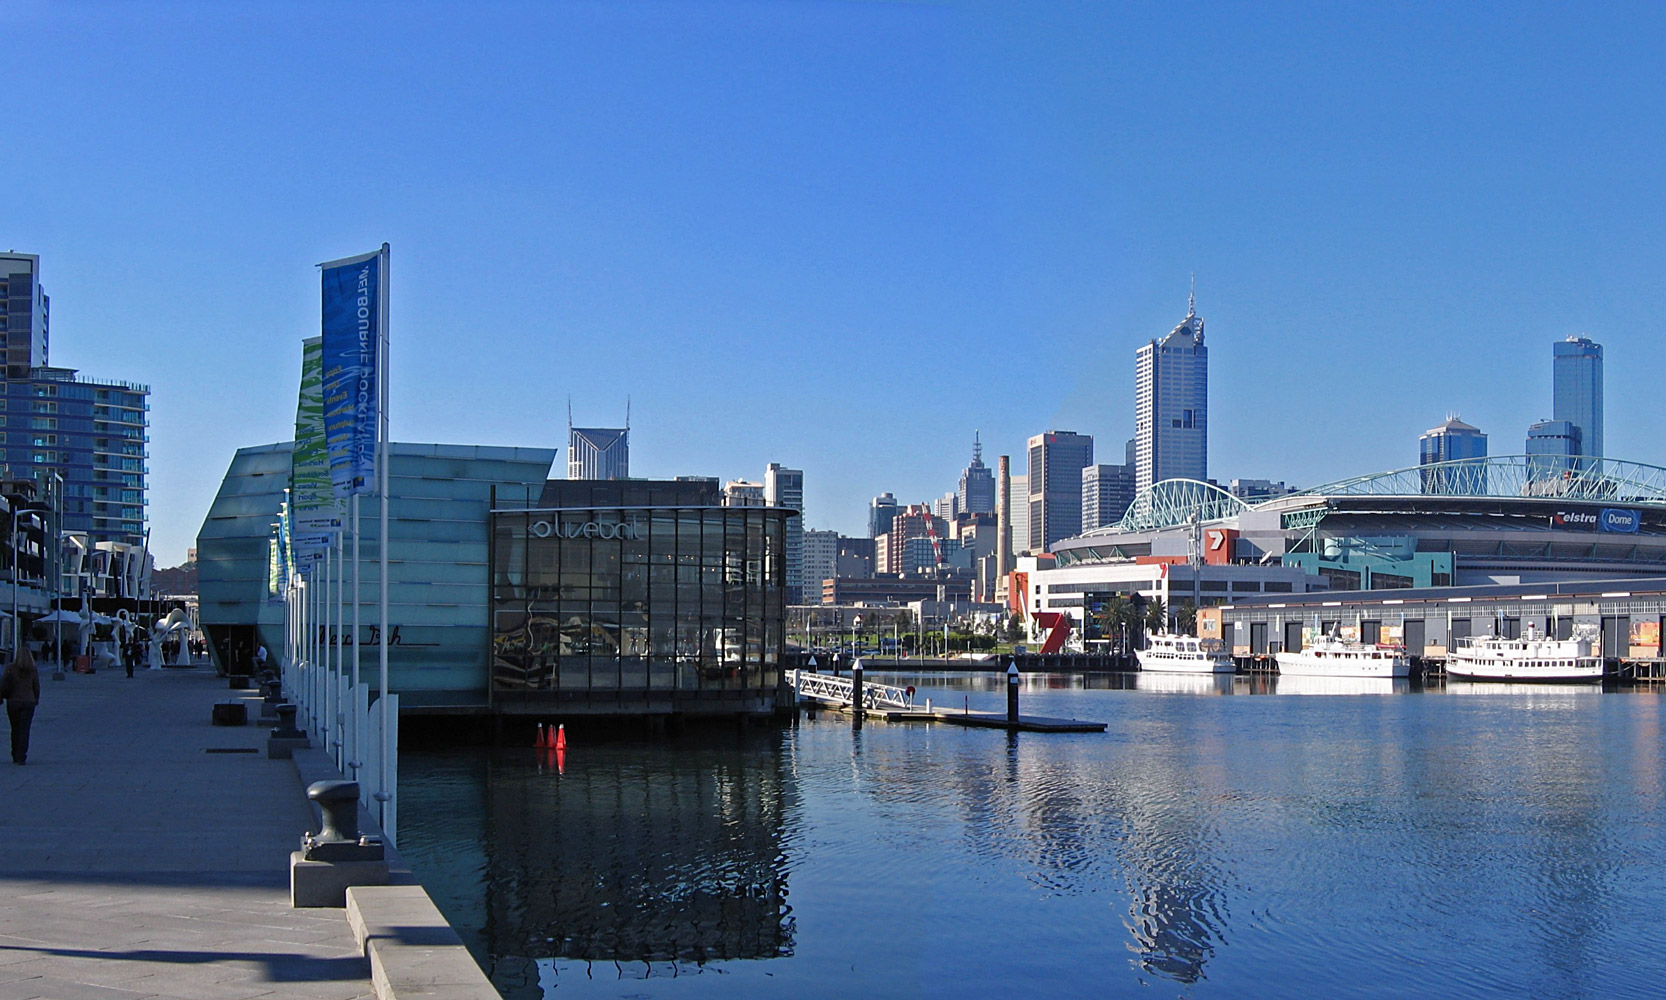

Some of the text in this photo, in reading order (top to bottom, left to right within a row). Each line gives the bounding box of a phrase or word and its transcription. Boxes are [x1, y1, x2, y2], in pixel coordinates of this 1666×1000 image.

[1555, 511, 1632, 525] Telstra Dome
[1208, 531, 1224, 550] 7
[313, 625, 358, 646] Mec
